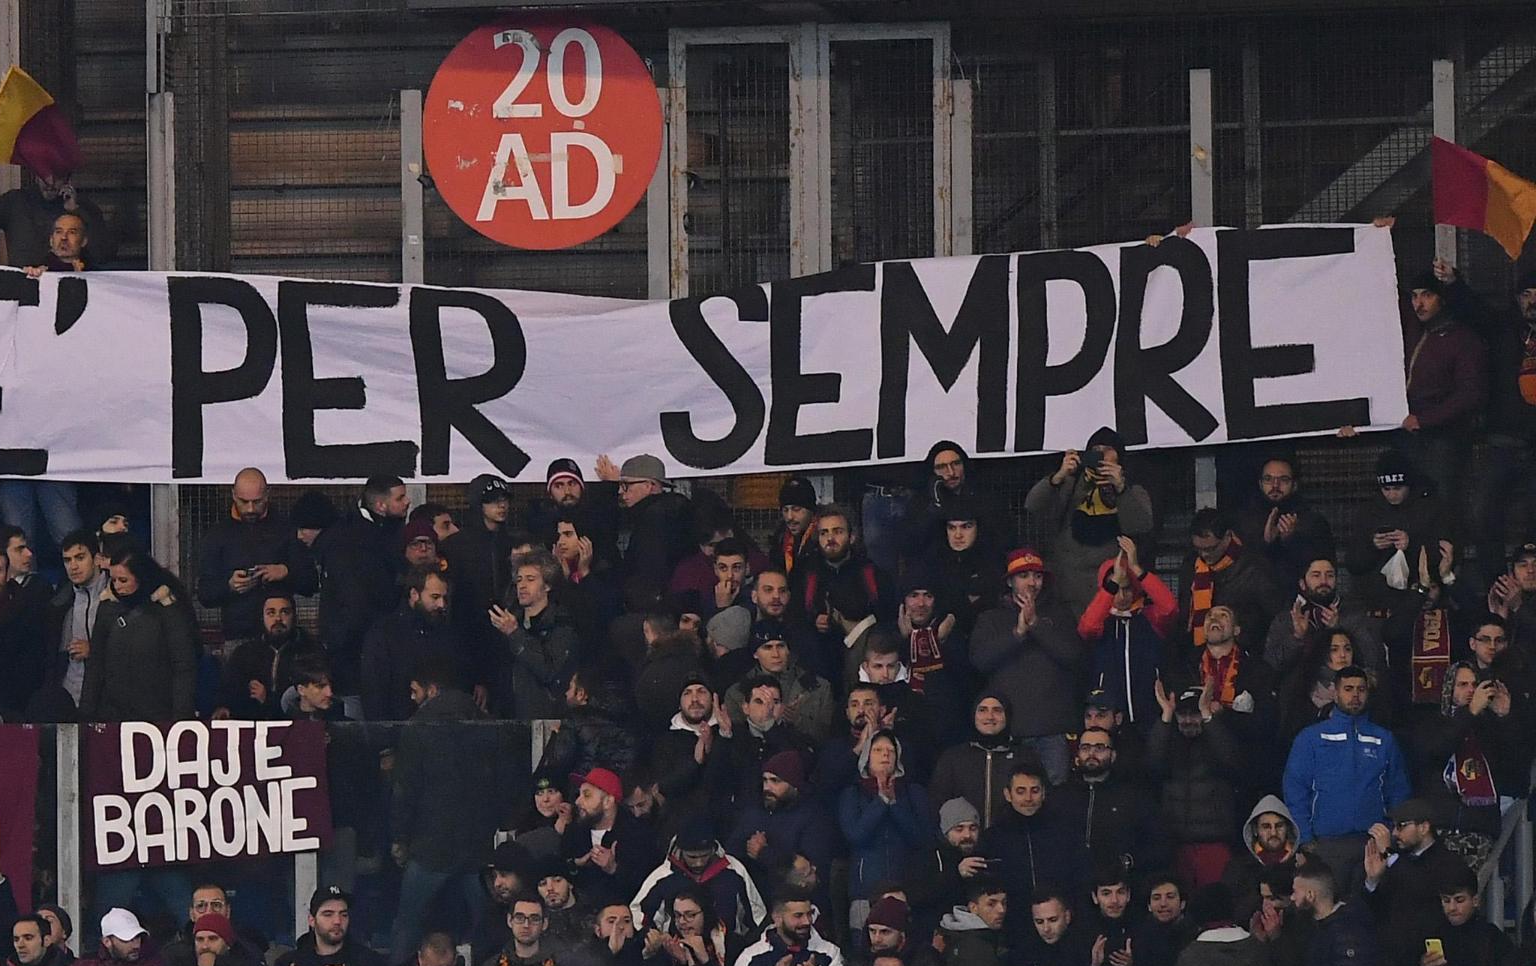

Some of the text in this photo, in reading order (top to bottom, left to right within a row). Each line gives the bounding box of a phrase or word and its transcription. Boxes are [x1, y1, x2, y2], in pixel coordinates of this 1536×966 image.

[492, 28, 603, 119] 20
[475, 131, 623, 221] AD
[167, 275, 532, 480] PER
[659, 227, 1371, 471] SEMPRE
[120, 719, 293, 793] DAJE
[92, 776, 320, 865] BARONE
